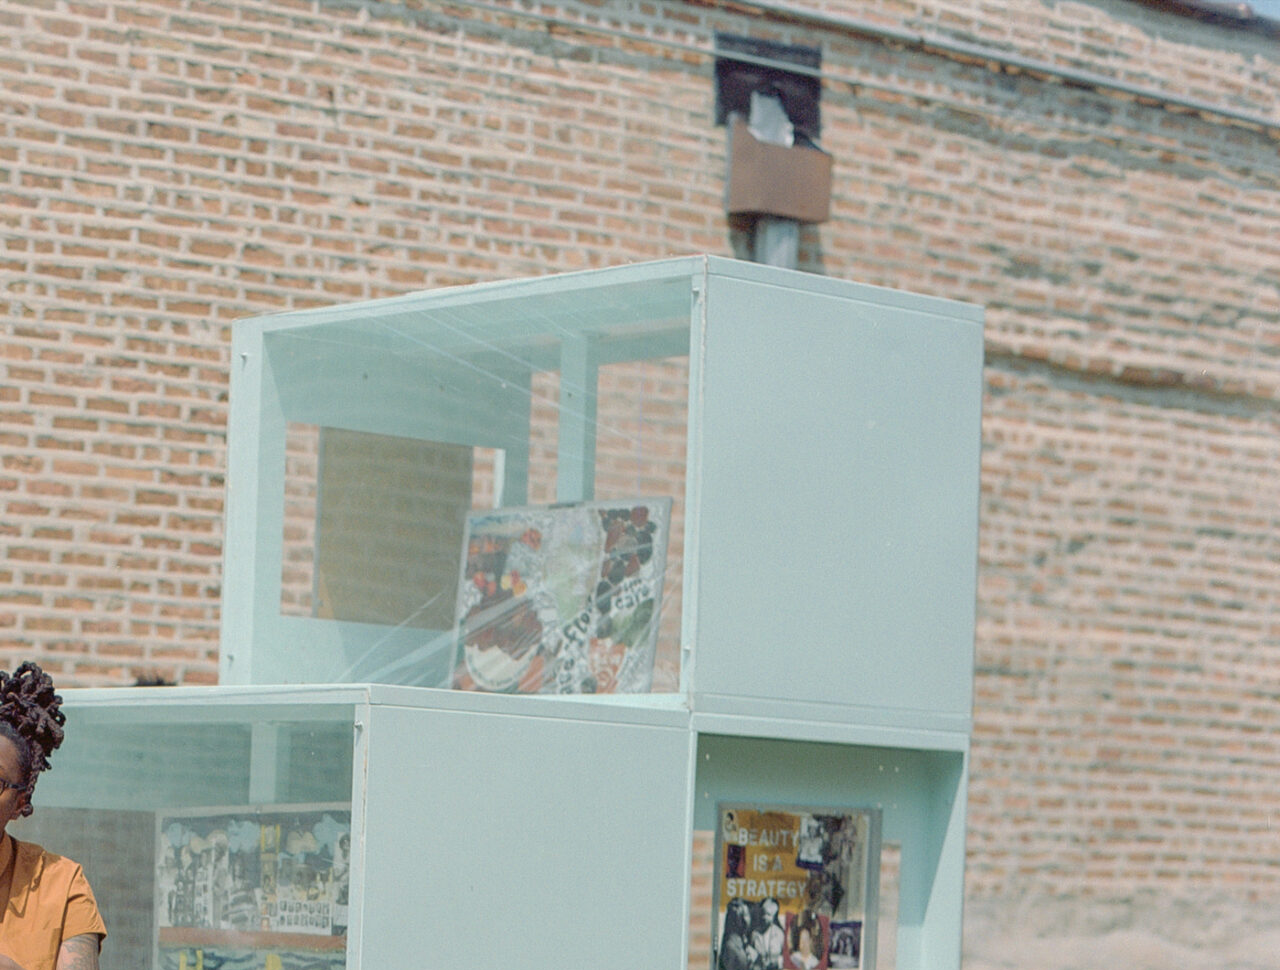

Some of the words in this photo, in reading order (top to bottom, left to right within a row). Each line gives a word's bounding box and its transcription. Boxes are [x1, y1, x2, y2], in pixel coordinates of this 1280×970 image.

[739, 828, 799, 848] BEAUTY
[753, 853, 768, 872] IS
[772, 854, 784, 872] A
[725, 879, 806, 899] STRATEGY
